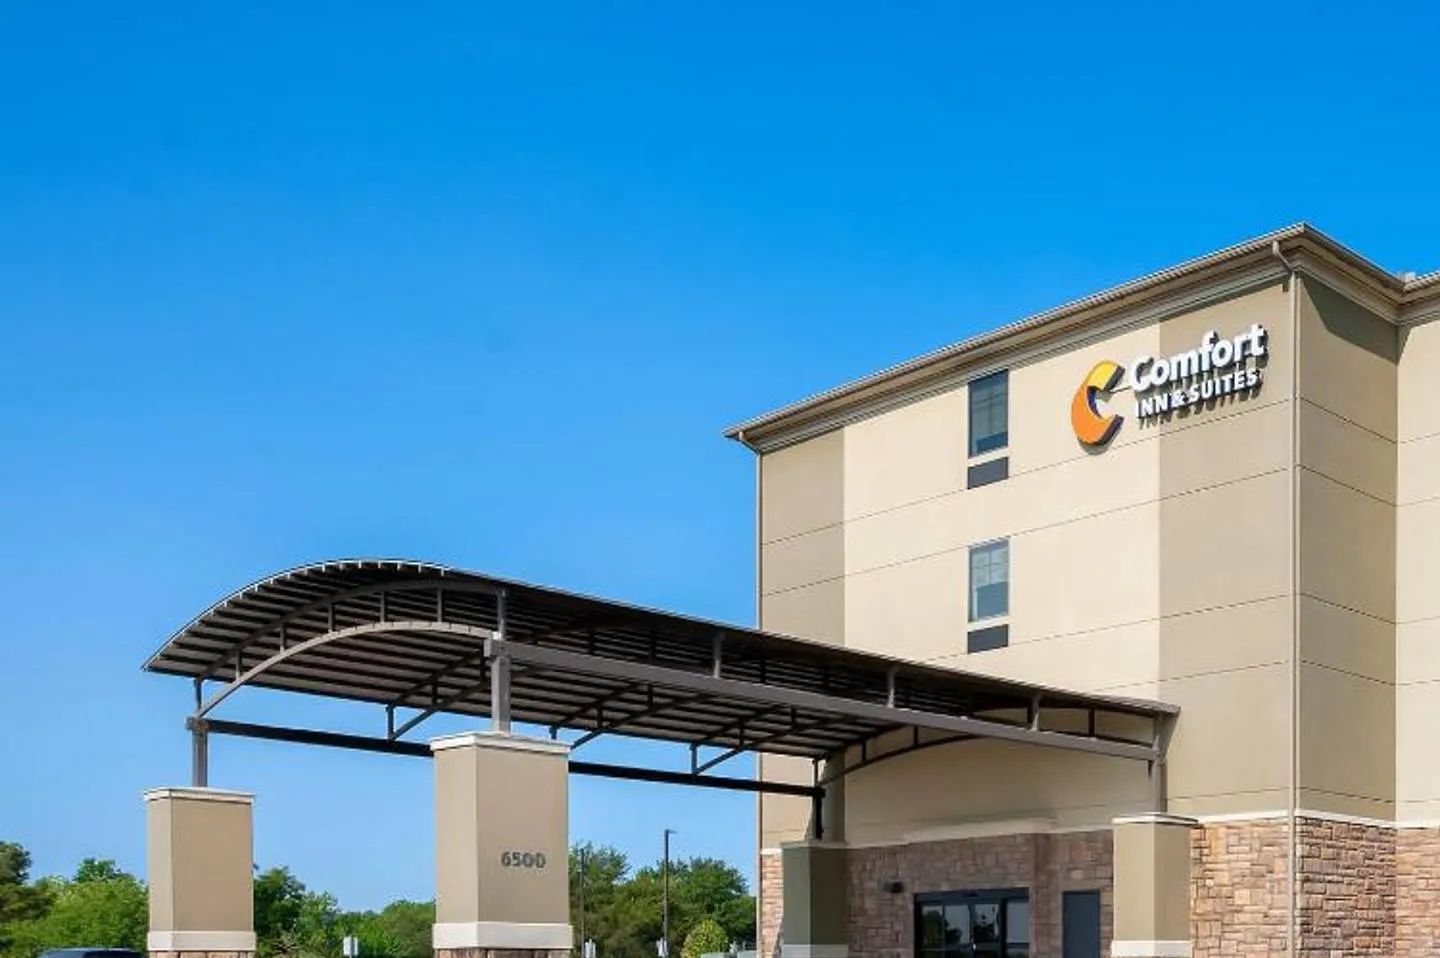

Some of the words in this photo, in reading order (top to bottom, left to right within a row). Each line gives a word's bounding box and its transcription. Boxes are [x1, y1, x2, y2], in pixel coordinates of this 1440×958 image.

[1130, 323, 1267, 392] Comfort
[1135, 396, 1170, 419] INN
[1191, 368, 1262, 403] SUITES
[502, 851, 546, 868] 6500
